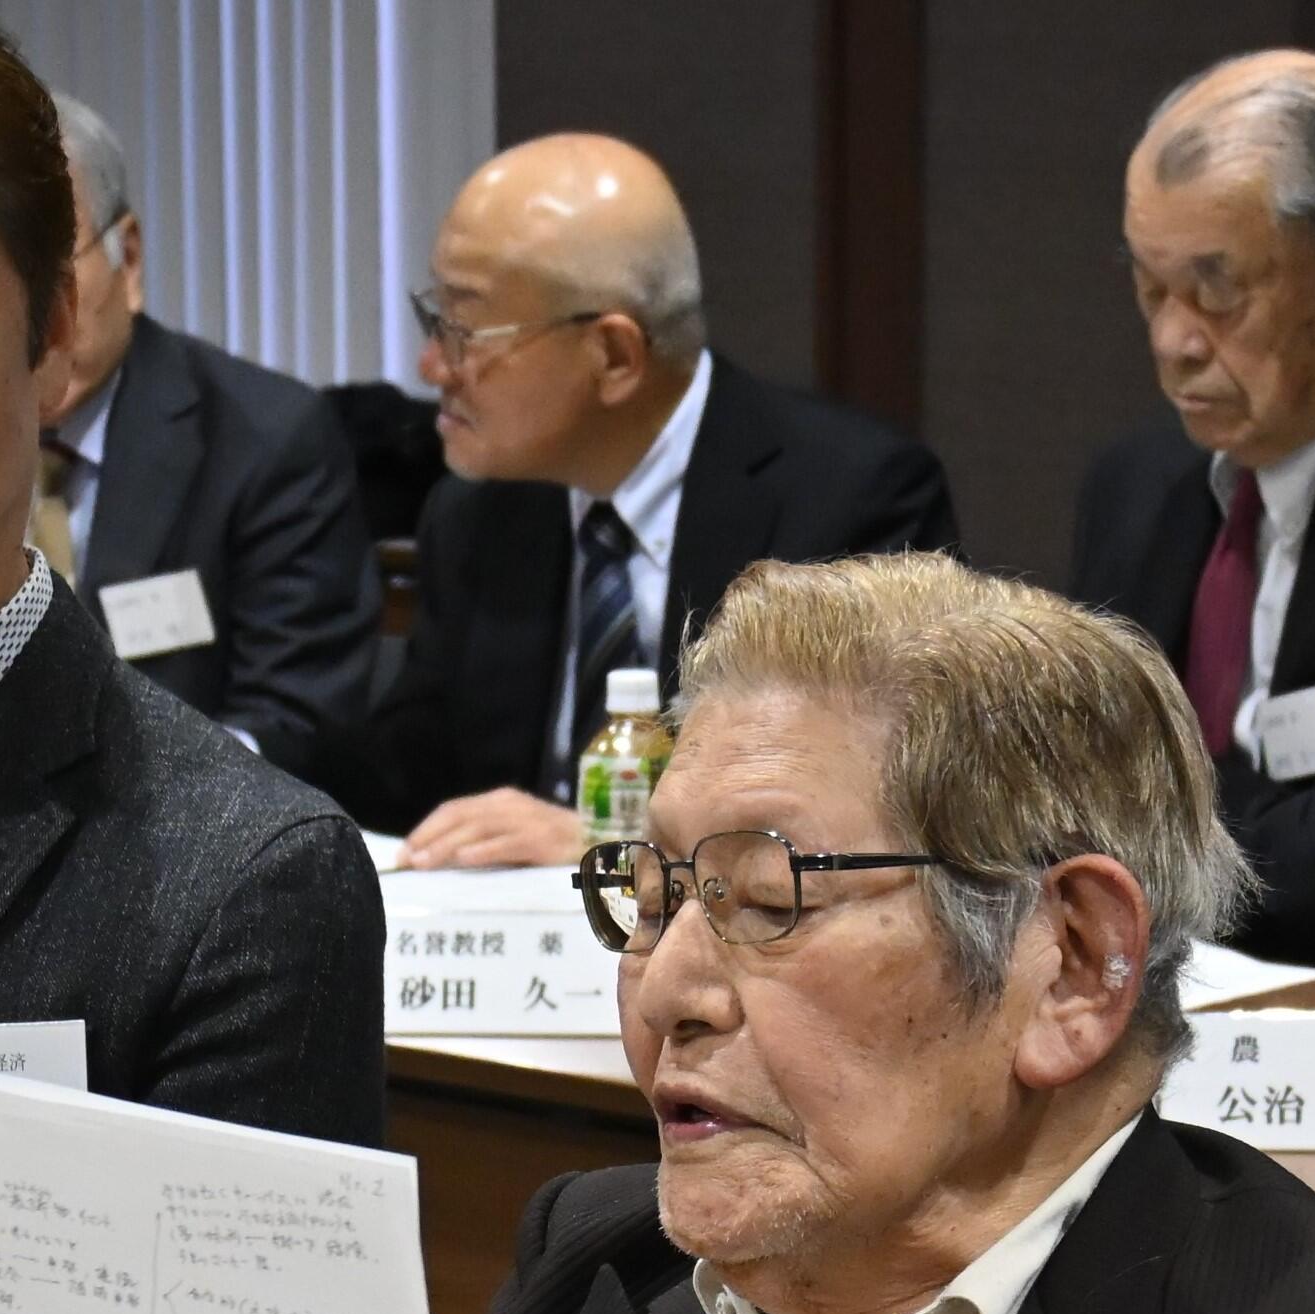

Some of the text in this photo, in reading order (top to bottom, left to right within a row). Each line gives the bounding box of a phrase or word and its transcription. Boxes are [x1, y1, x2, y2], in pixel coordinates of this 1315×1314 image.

[397, 930, 563, 956] 名誉教授 薬
[400, 976, 602, 1012] 砂田 久一
[1231, 1035, 1260, 1063] 農
[1219, 1085, 1305, 1126] 公治
